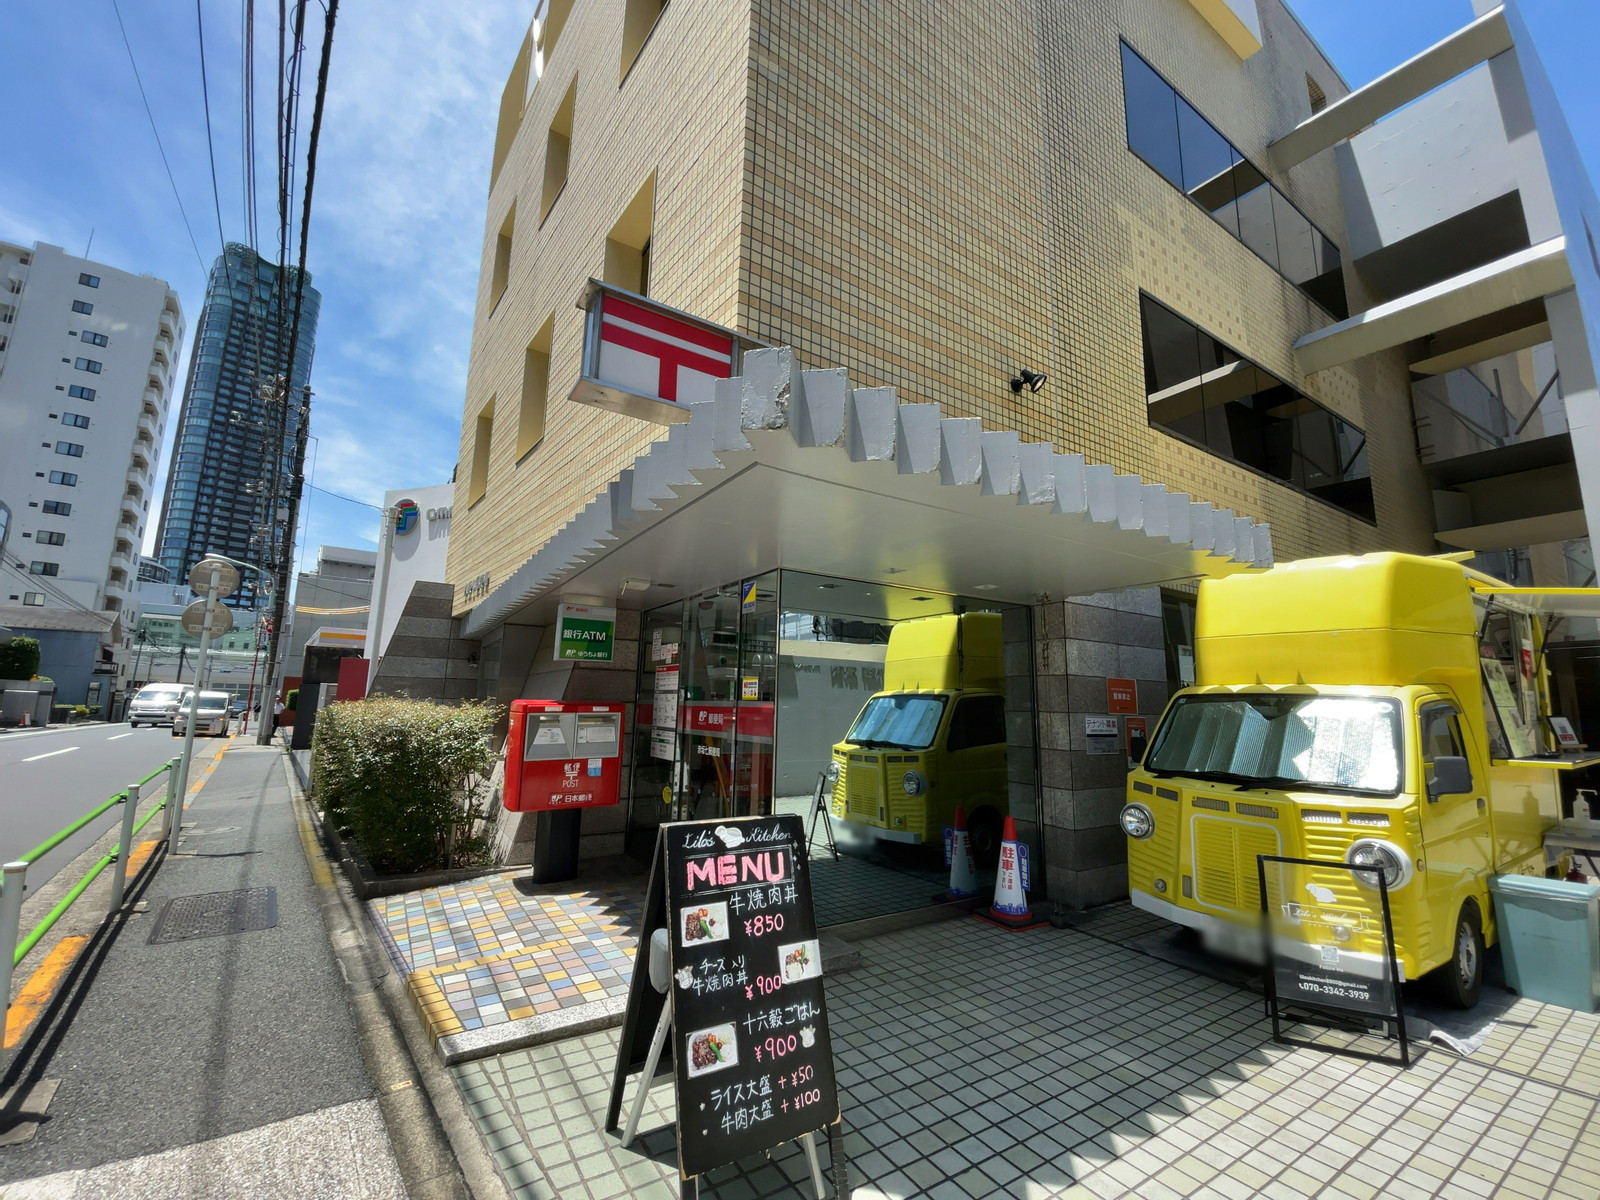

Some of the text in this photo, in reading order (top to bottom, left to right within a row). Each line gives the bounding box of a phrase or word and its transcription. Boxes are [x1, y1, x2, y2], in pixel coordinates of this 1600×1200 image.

[563, 629, 606, 641] 銀行ATM
[1086, 719, 1117, 728] テナント募集
[564, 762, 581, 773] 郵便
[562, 780, 580, 788] POST
[682, 823, 793, 850] Lilo's Kitchen
[686, 851, 785, 891] MENU
[1002, 846, 1015, 871] 駐車
[729, 883, 798, 916] 牛焼肉丼
[744, 913, 784, 937] ¥850
[691, 970, 749, 997] 牛焼肉丼
[744, 974, 782, 1001] ¥900
[1303, 982, 1370, 1000] 070-3342-3939
[742, 1001, 821, 1035] 十六穀ごはん
[754, 1034, 797, 1063] ¥900
[710, 1074, 773, 1111] ライス大盛
[721, 1098, 775, 1136] 牛肉大盛
[793, 1088, 821, 1110] ¥100
